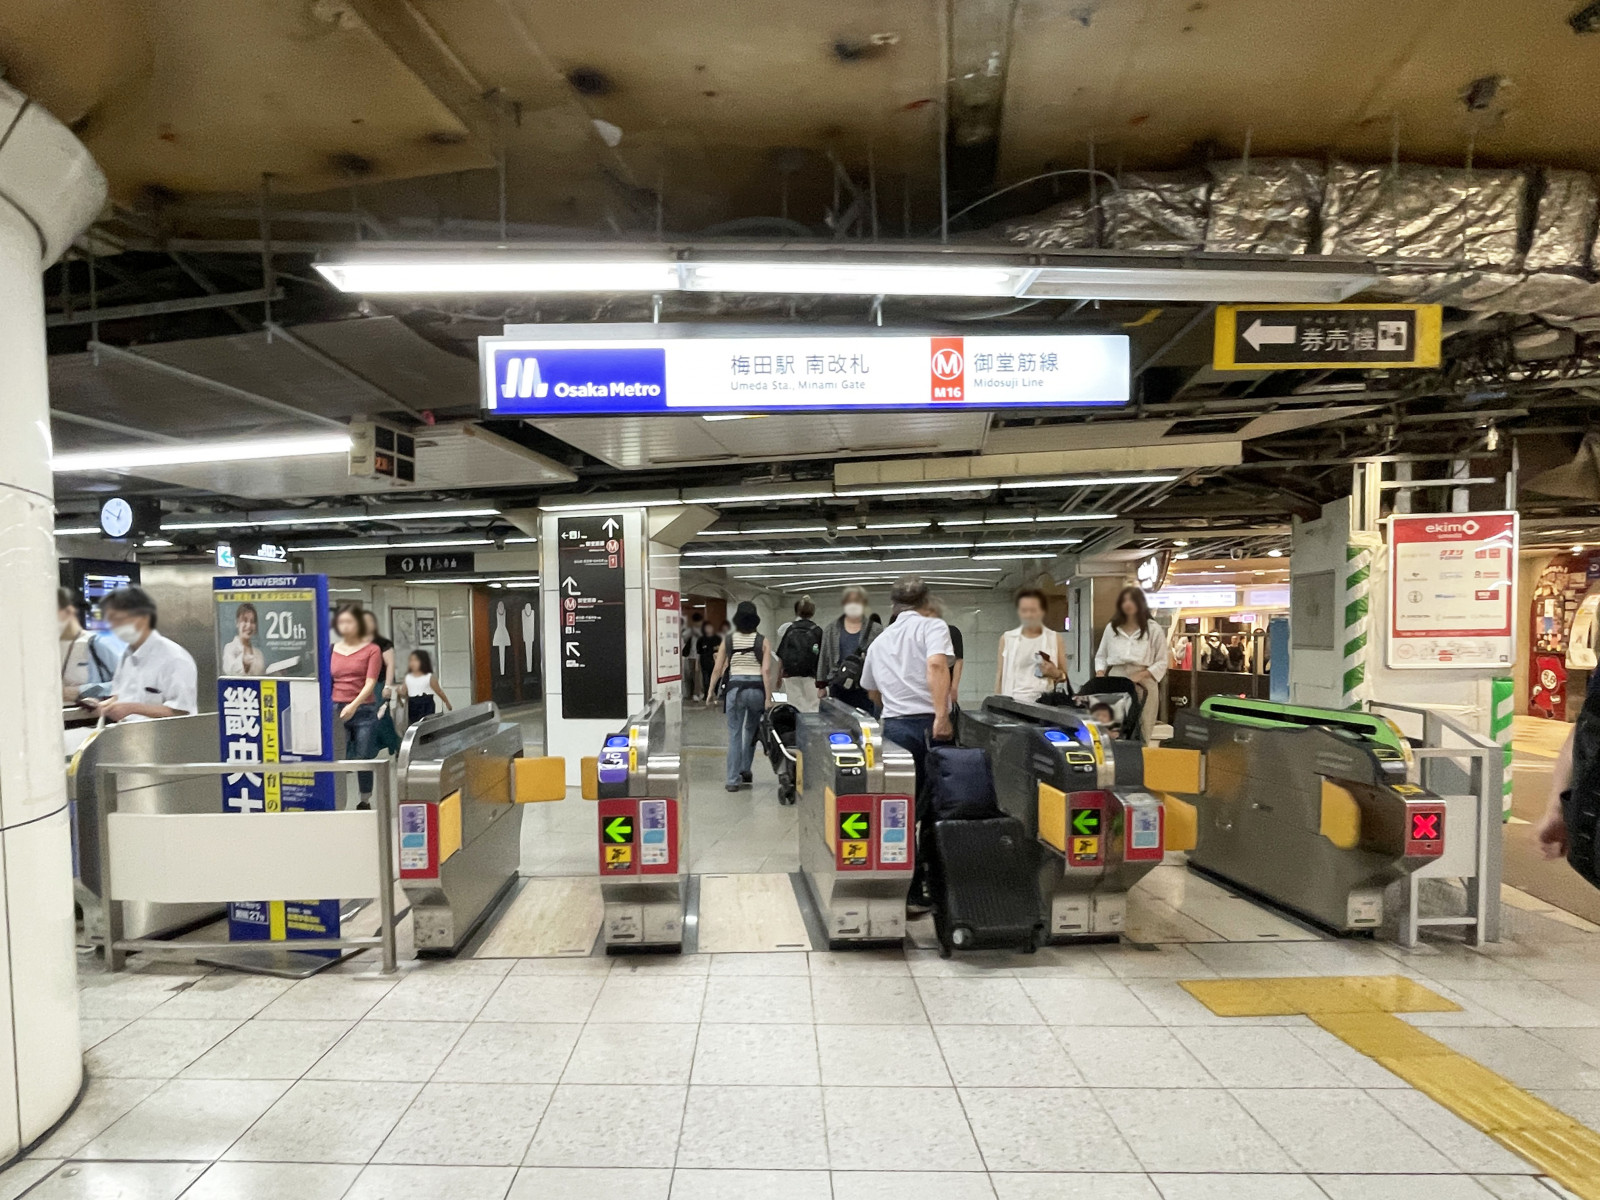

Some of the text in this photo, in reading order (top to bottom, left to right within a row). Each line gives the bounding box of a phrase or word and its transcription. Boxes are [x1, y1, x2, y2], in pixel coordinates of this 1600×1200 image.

[730, 353, 870, 376] 梅田駅 南改札
[973, 352, 1059, 373] 御堂筋線
[554, 382, 660, 398] Osaka Metro
[730, 381, 768, 391] Umeda
[798, 380, 838, 390] Minami
[841, 380, 866, 389] Gate
[973, 378, 1044, 389] Midosuji Line
[934, 387, 962, 398] M16
[248, 577, 298, 586] UNIVERSITY
[265, 611, 307, 639] 20th
